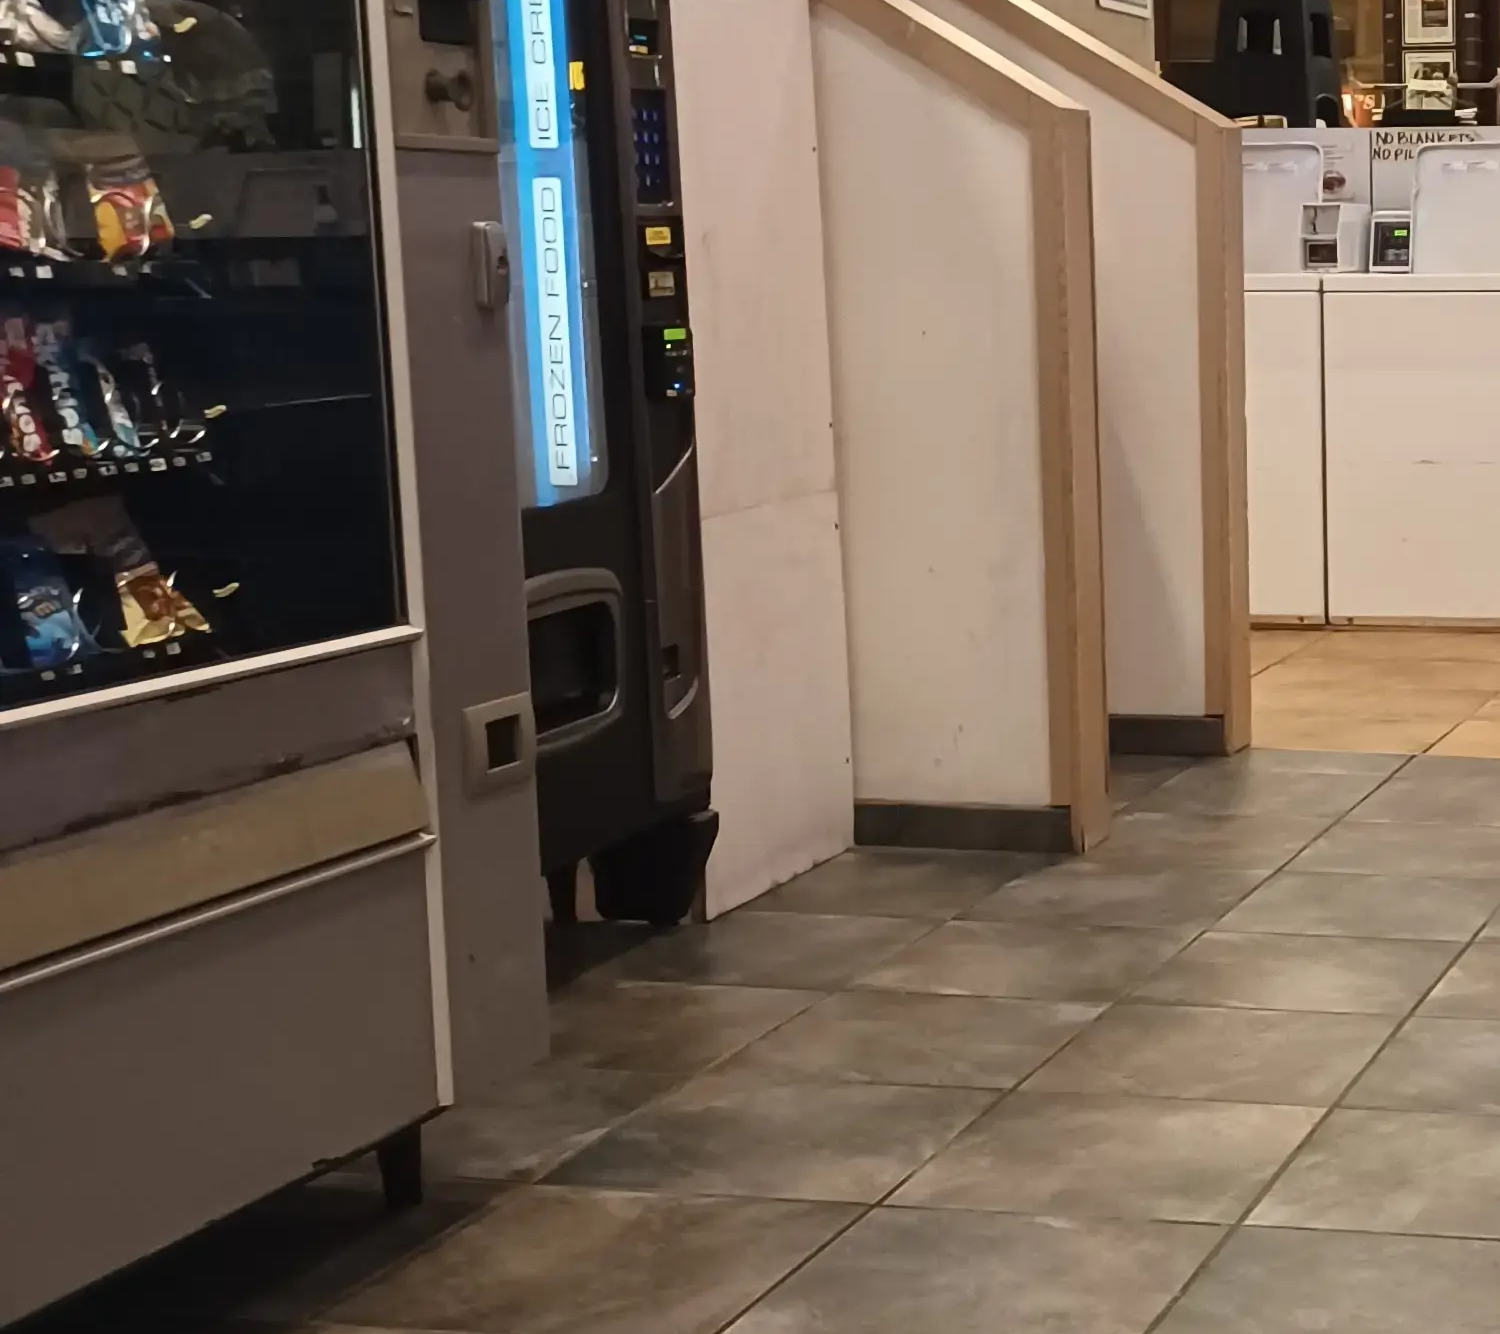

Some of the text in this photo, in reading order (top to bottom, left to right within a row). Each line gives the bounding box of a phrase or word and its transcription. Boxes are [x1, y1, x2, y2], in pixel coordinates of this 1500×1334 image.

[535, 81, 551, 140] ICE
[1372, 146, 1391, 160] NO
[1375, 131, 1394, 145] NO
[541, 186, 570, 470] FROZEN FOOD
